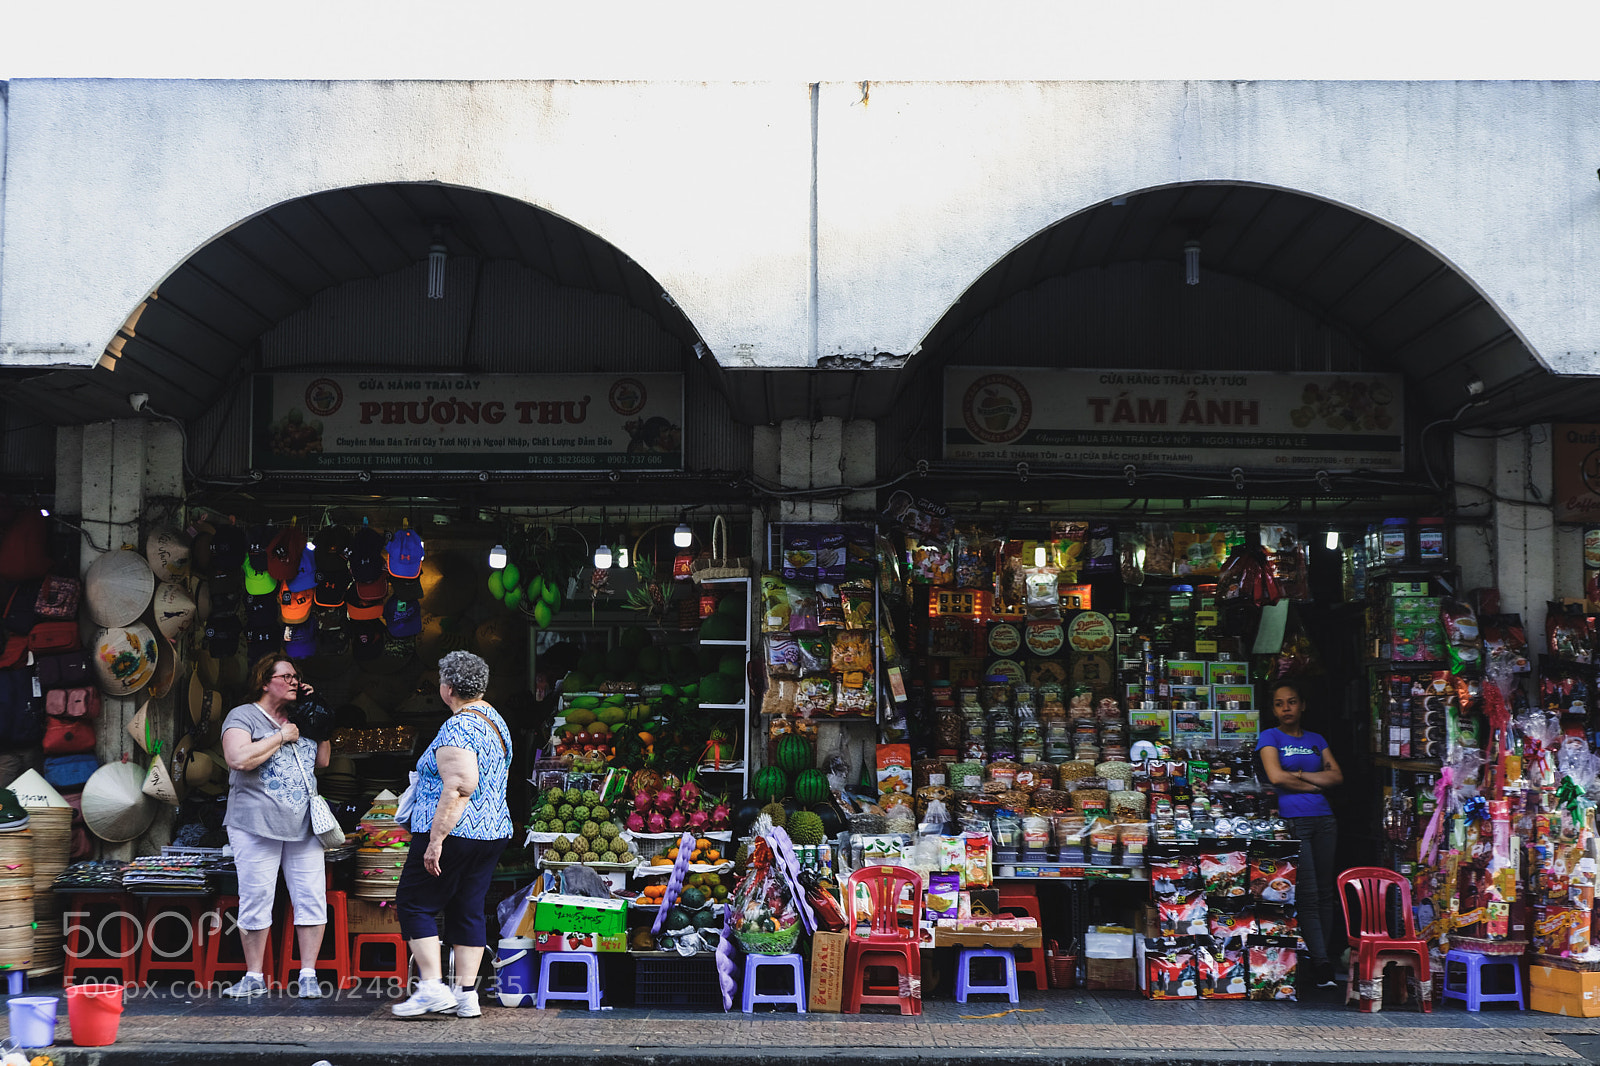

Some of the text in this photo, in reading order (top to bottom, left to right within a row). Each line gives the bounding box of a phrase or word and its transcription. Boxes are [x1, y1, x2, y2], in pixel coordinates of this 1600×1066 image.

[359, 395, 507, 425] PHƯƠNG
[514, 395, 592, 425] THƯ
[1178, 387, 1262, 426] ẢNH
[369, 437, 385, 446] Mua
[1281, 745, 1314, 757] Venice
